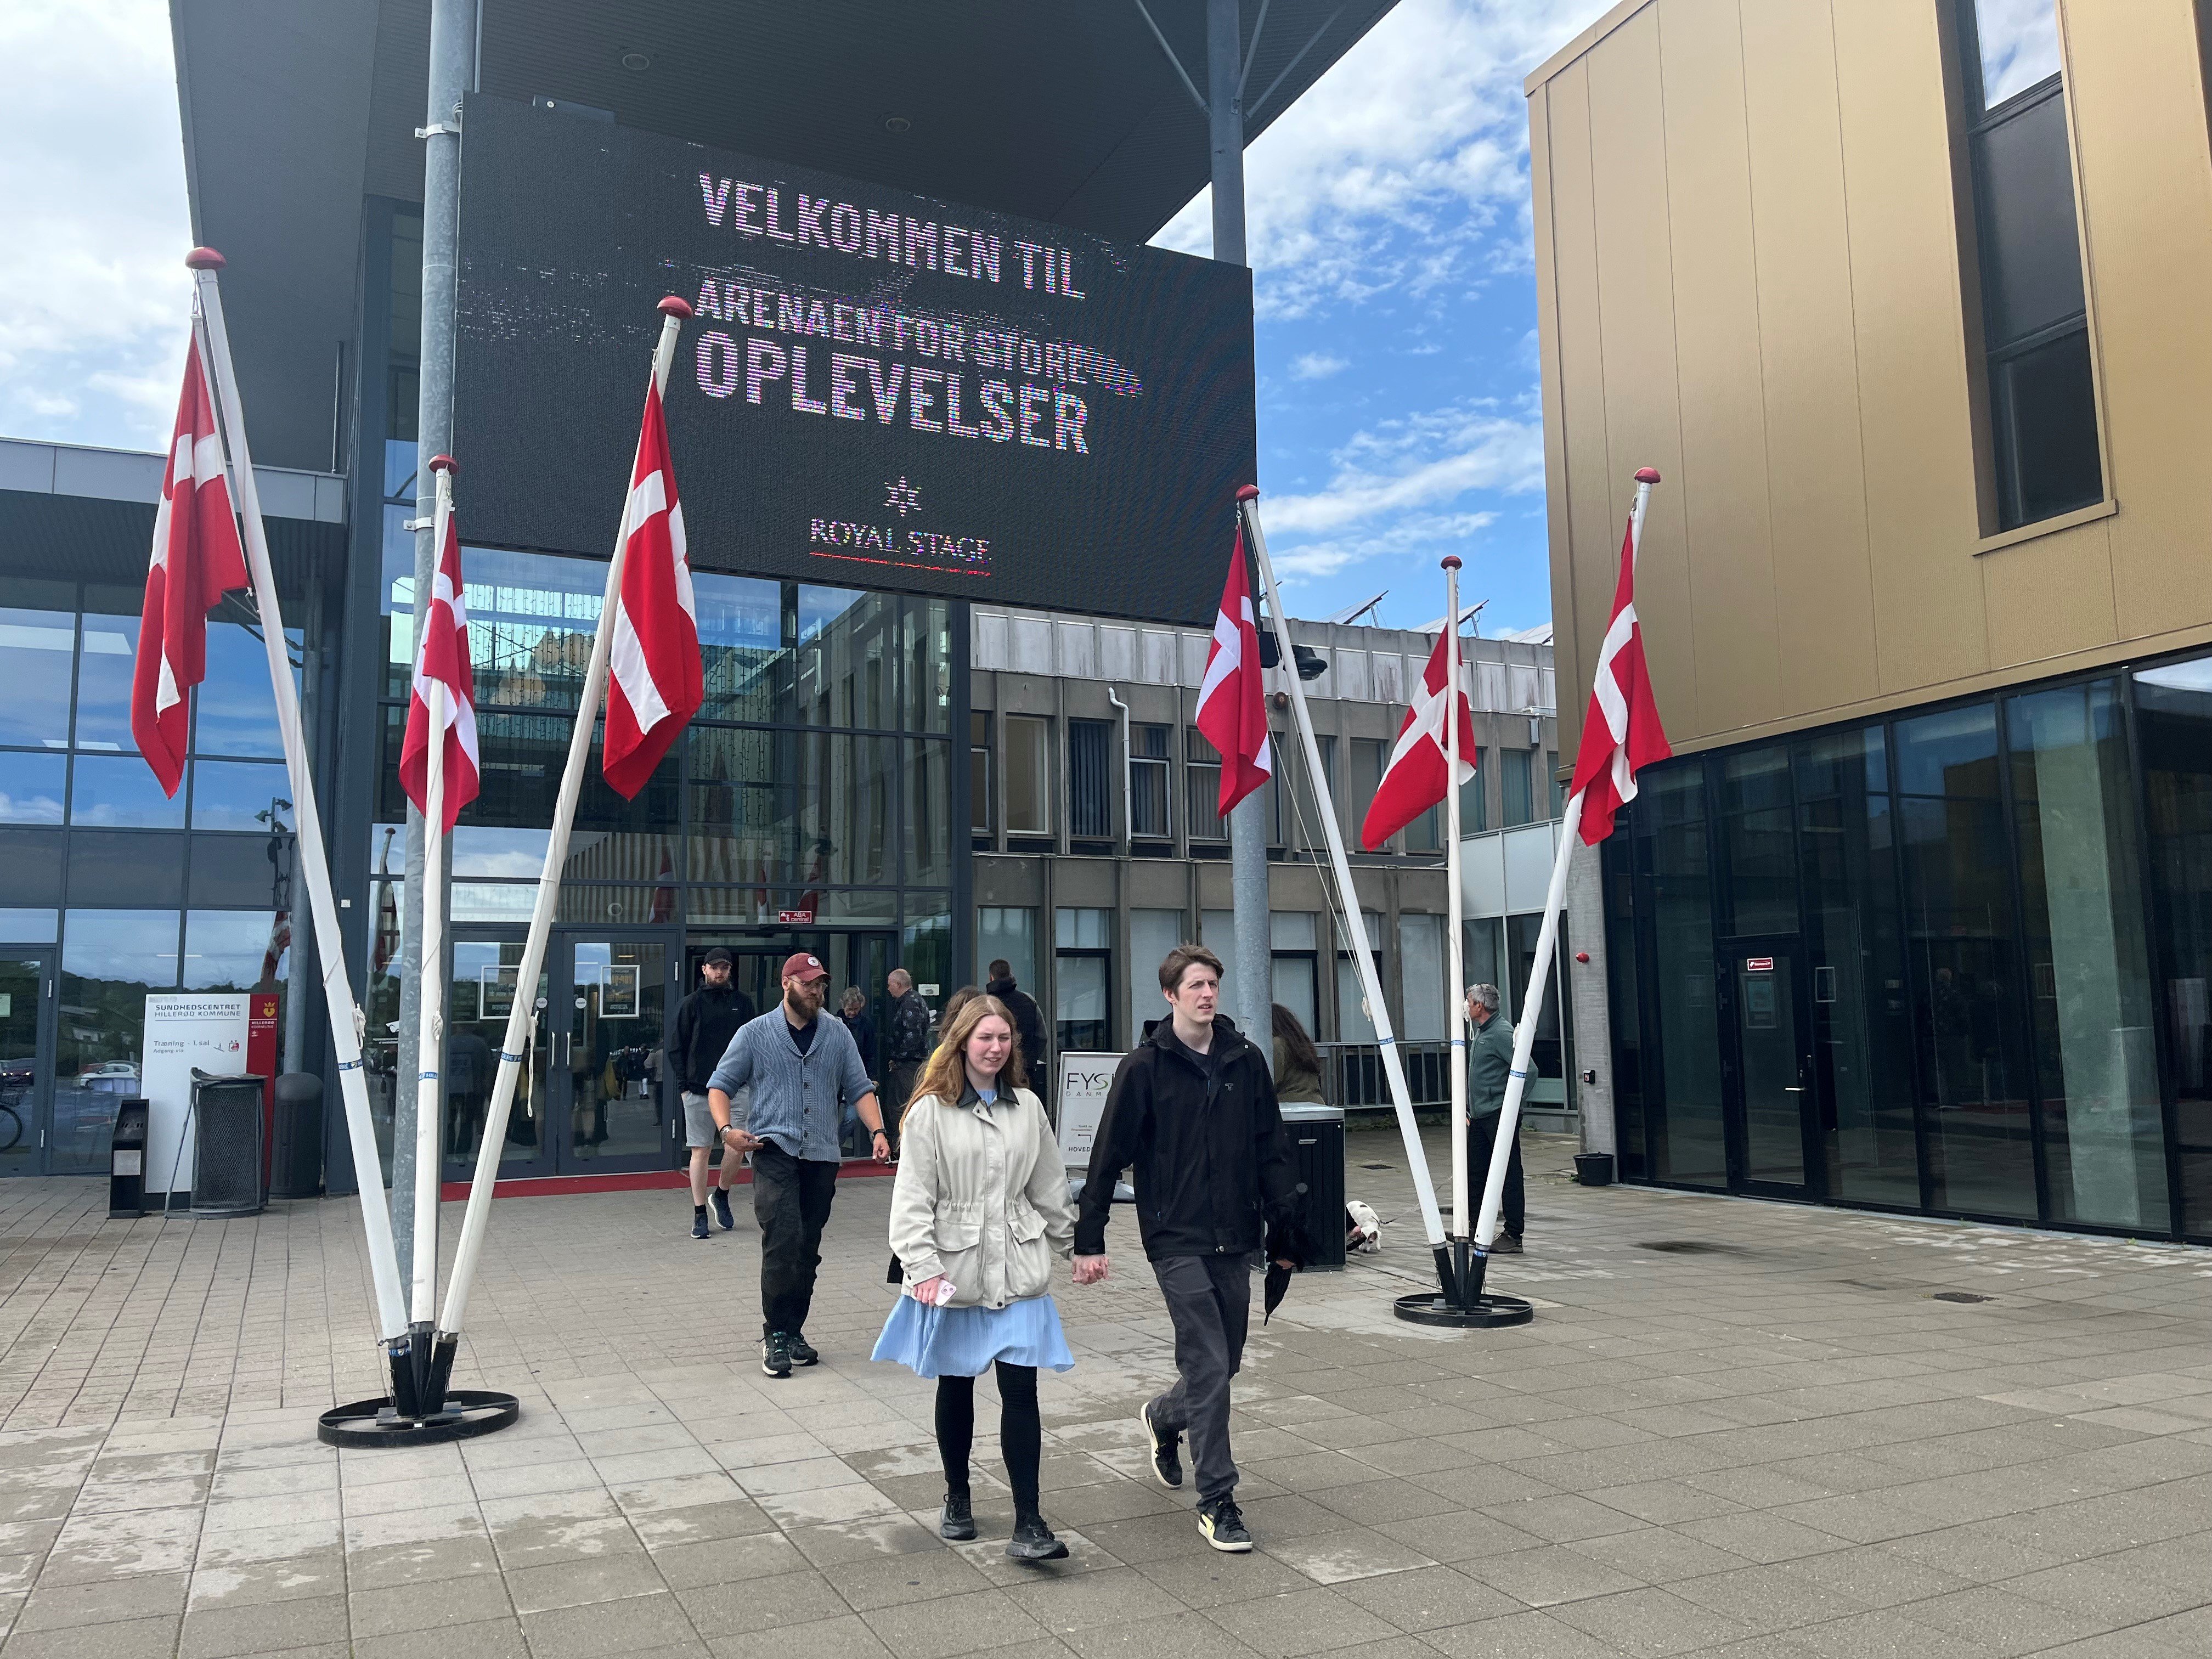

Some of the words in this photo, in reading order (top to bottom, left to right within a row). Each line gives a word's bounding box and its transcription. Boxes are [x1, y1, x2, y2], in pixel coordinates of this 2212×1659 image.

[698, 171, 1001, 284] VELKOMMEN
[1015, 239, 1086, 301] TIL
[694, 276, 881, 346] ARENAEN
[894, 309, 968, 362] FOR
[973, 329, 1087, 385] STORE
[696, 330, 1088, 455] OPLEVELSER
[810, 517, 901, 552] ROYAL
[907, 530, 992, 563] STAGE
